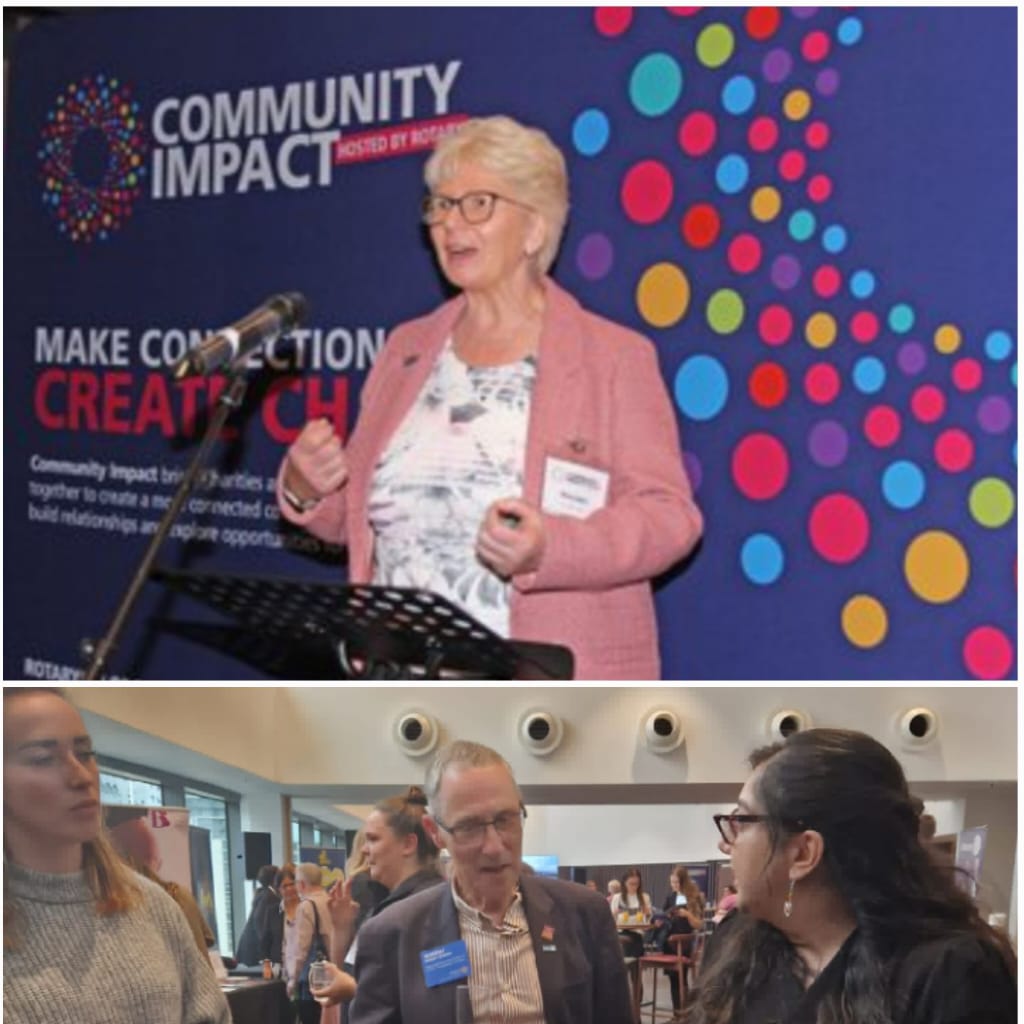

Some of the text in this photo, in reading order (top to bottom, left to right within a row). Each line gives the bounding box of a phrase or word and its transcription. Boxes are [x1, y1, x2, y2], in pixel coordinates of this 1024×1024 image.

[152, 60, 462, 145] COMMUNITY
[337, 136, 388, 160] HOSTED
[389, 132, 409, 152] BY
[151, 129, 341, 199] IMPACT
[34, 327, 131, 366] MAKE
[29, 453, 106, 483] Community
[109, 460, 159, 484] Impact
[28, 480, 80, 502] together
[83, 486, 97, 502] to
[98, 489, 139, 507] create
[28, 501, 60, 523] build
[60, 507, 139, 535] relationships
